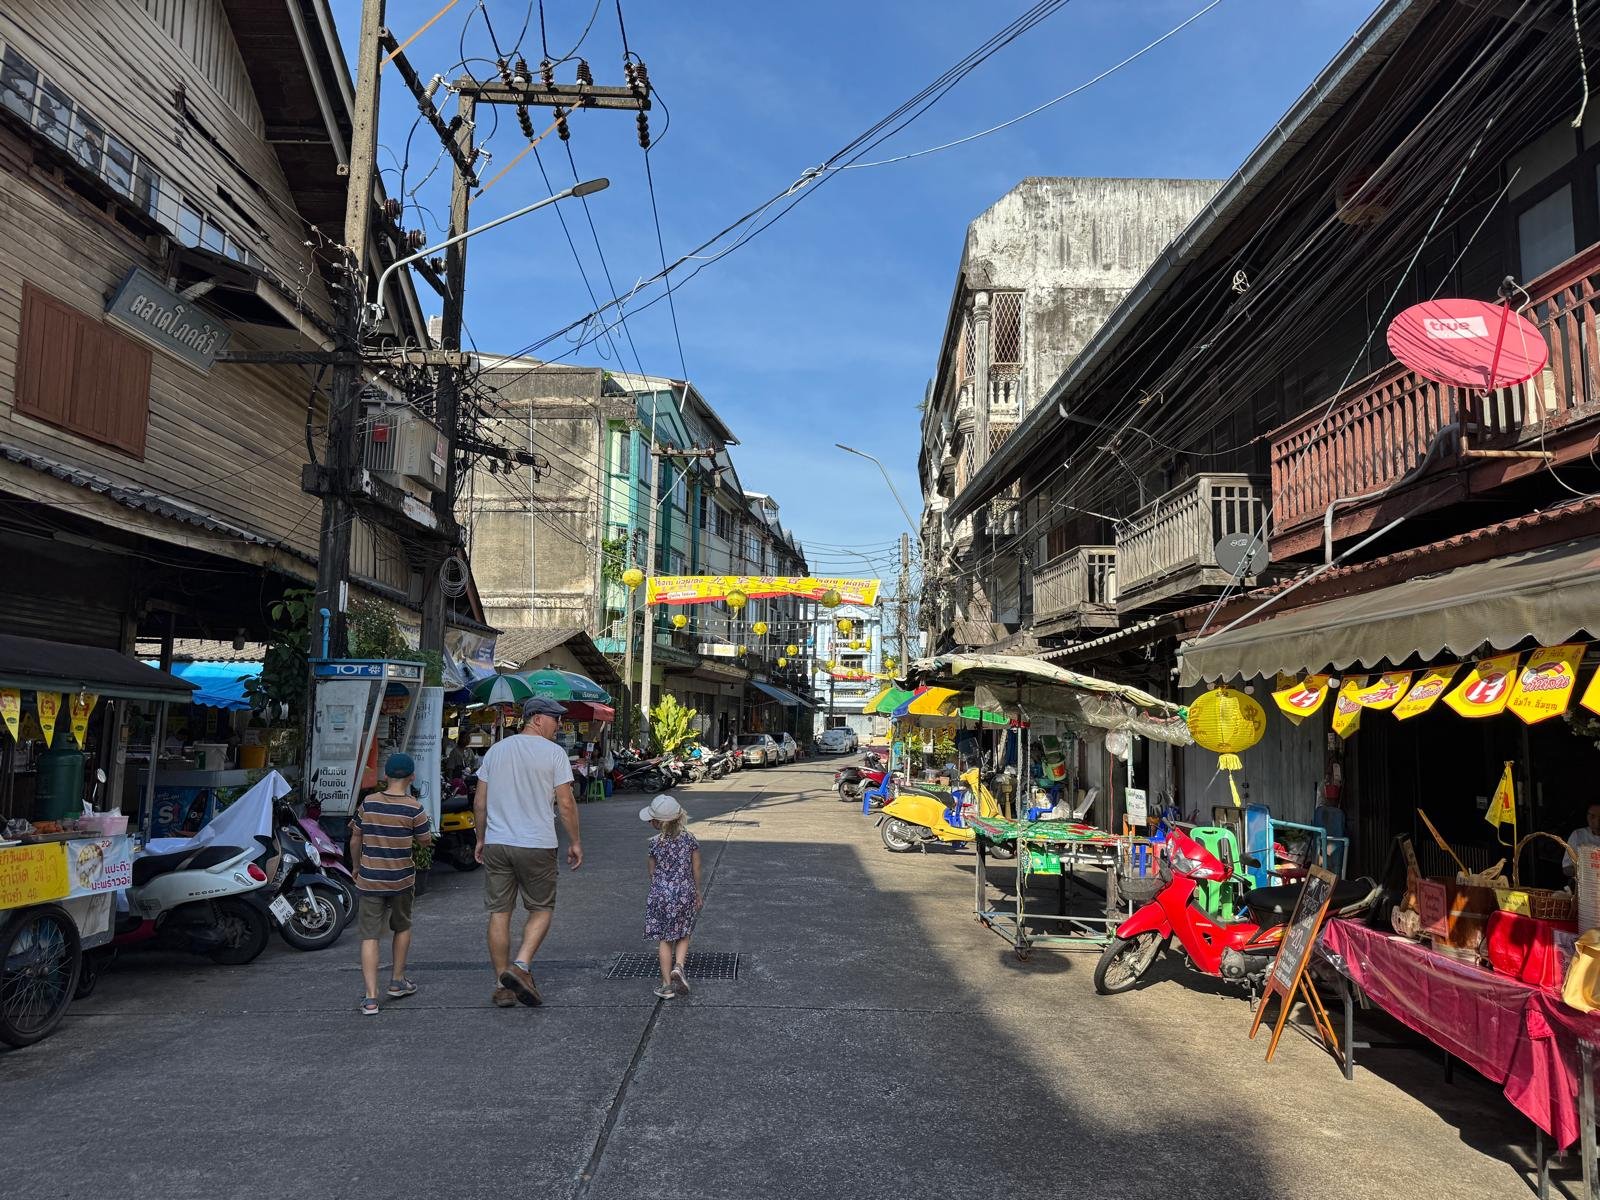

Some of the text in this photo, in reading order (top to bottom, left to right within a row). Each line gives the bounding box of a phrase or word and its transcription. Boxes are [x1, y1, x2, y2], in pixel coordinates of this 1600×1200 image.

[1429, 321, 1470, 331] true
[330, 664, 369, 674] TOT
[319, 778, 346, 787] โอนเงิน
